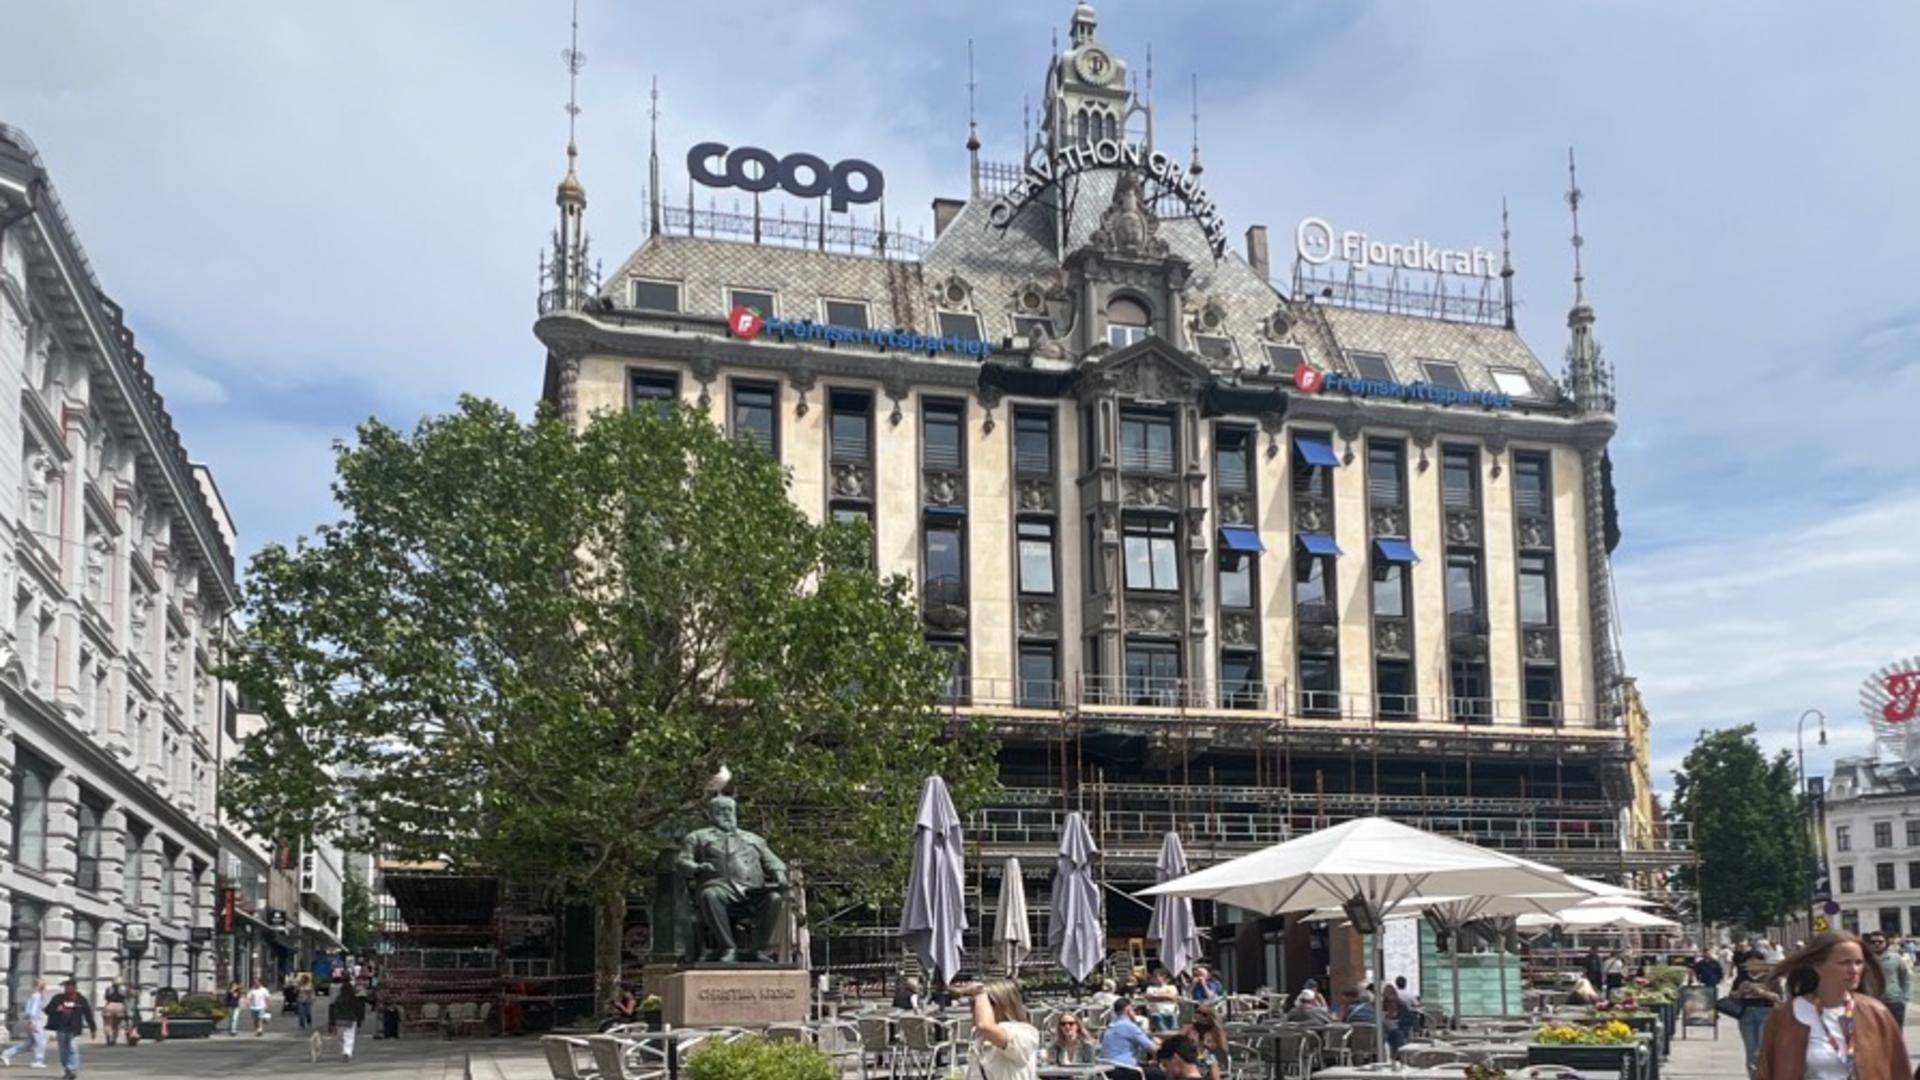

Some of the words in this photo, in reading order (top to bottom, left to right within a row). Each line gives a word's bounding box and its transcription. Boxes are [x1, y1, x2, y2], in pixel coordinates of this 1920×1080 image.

[687, 142, 884, 213] coop
[1059, 139, 1141, 171] THON
[1343, 231, 1497, 279] Fjordkraft
